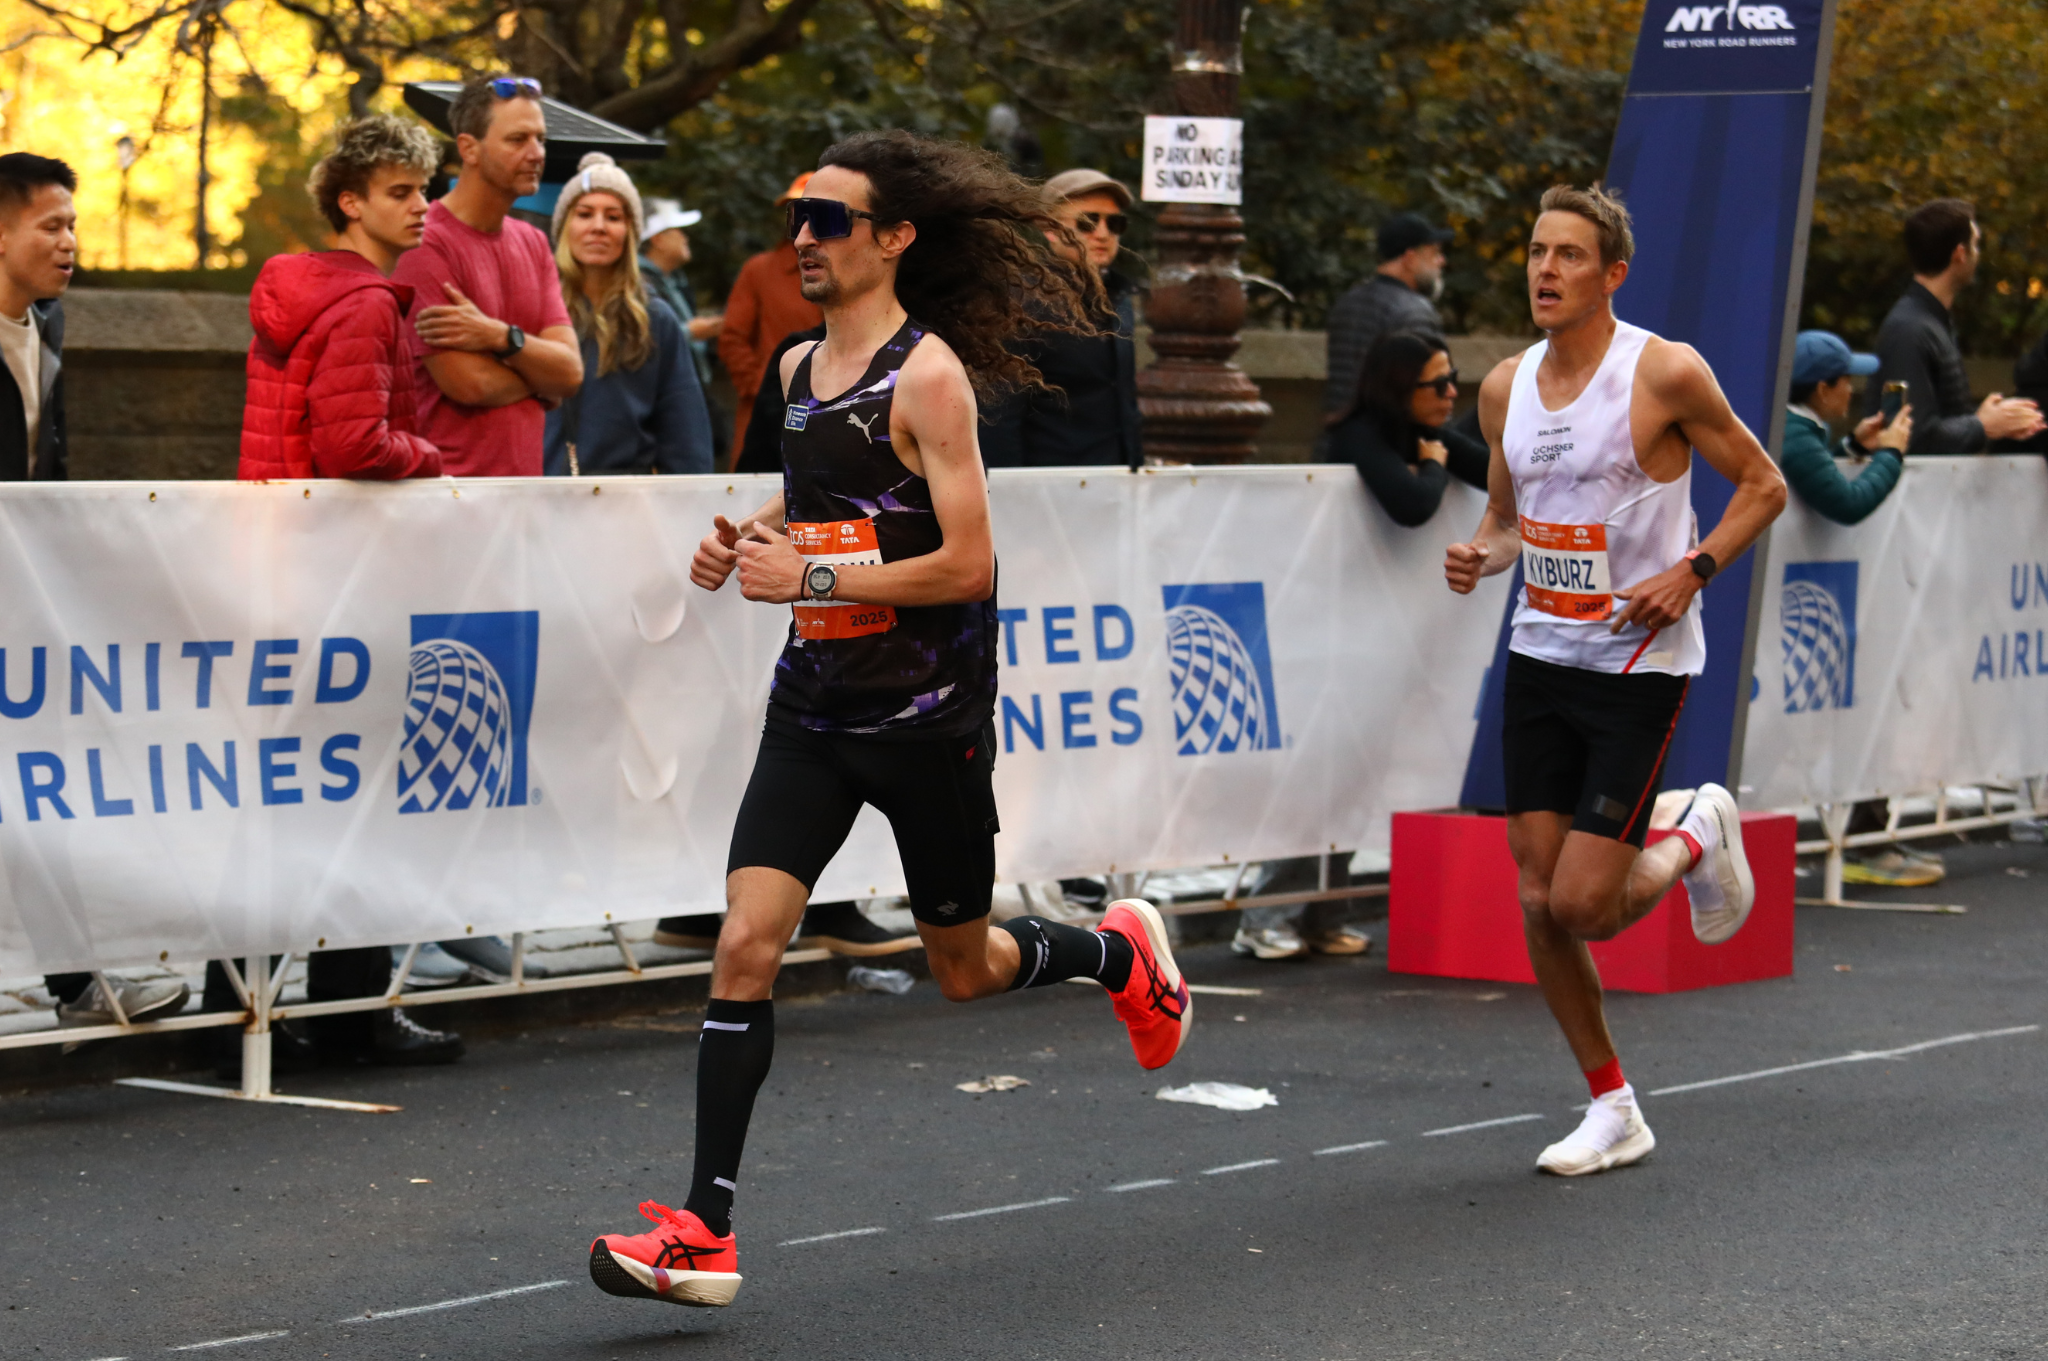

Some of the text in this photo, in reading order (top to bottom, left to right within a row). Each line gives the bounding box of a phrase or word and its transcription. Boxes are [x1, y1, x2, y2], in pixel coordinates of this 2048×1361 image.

[1663, 37, 1797, 48] NEW YORK ROAD RUNNERS
[1176, 124, 1198, 141] NO
[1532, 443, 1574, 455] OCHSNER
[1530, 453, 1561, 464] SPORT
[840, 537, 860, 545] TATA
[1527, 551, 1596, 590] KYBURZ
[1574, 602, 1607, 613] 2025
[849, 611, 889, 627] 2025
[0, 637, 371, 719] UNITED
[0, 733, 361, 824] RLINES
